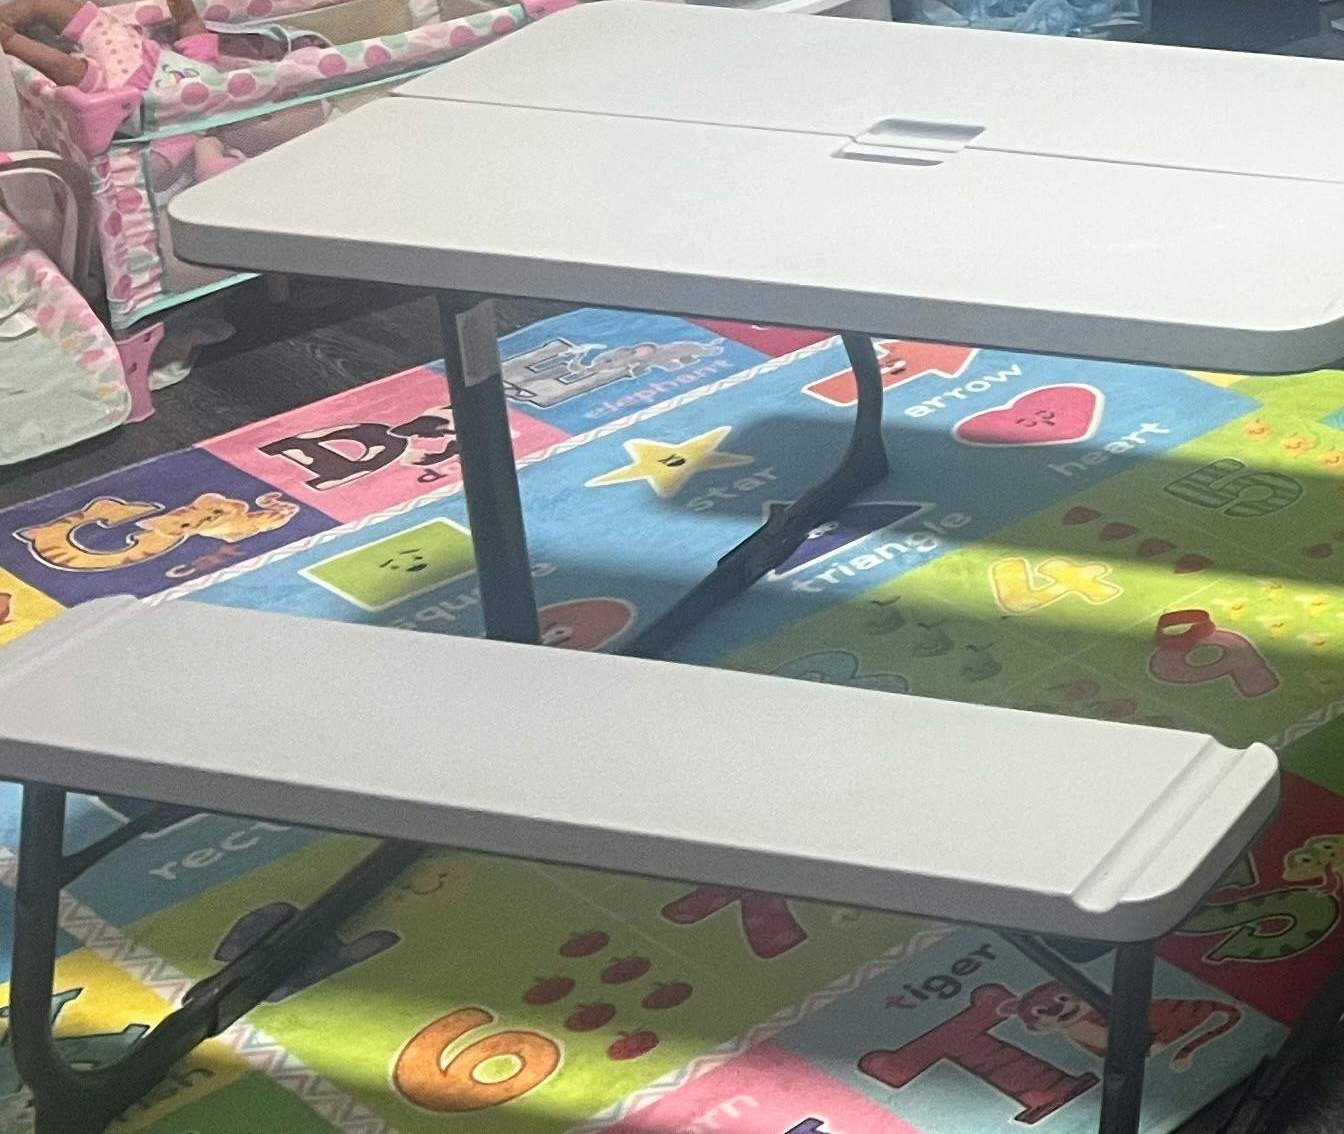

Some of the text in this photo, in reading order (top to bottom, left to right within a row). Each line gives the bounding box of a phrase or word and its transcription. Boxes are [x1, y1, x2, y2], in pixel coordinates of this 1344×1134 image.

[588, 358, 729, 419] elephant
[903, 363, 1026, 420] arrow
[255, 421, 410, 492] D
[1050, 418, 1172, 477] heart
[684, 463, 782, 514] star
[1163, 457, 1304, 518] 5
[12, 496, 198, 572] C
[165, 544, 245, 579] cat
[790, 507, 974, 595] triangle
[988, 556, 1124, 616] 4
[1147, 608, 1283, 699] 9
[882, 941, 999, 1011] tiger
[391, 1006, 564, 1114] 6
[857, 982, 1102, 1126] T
